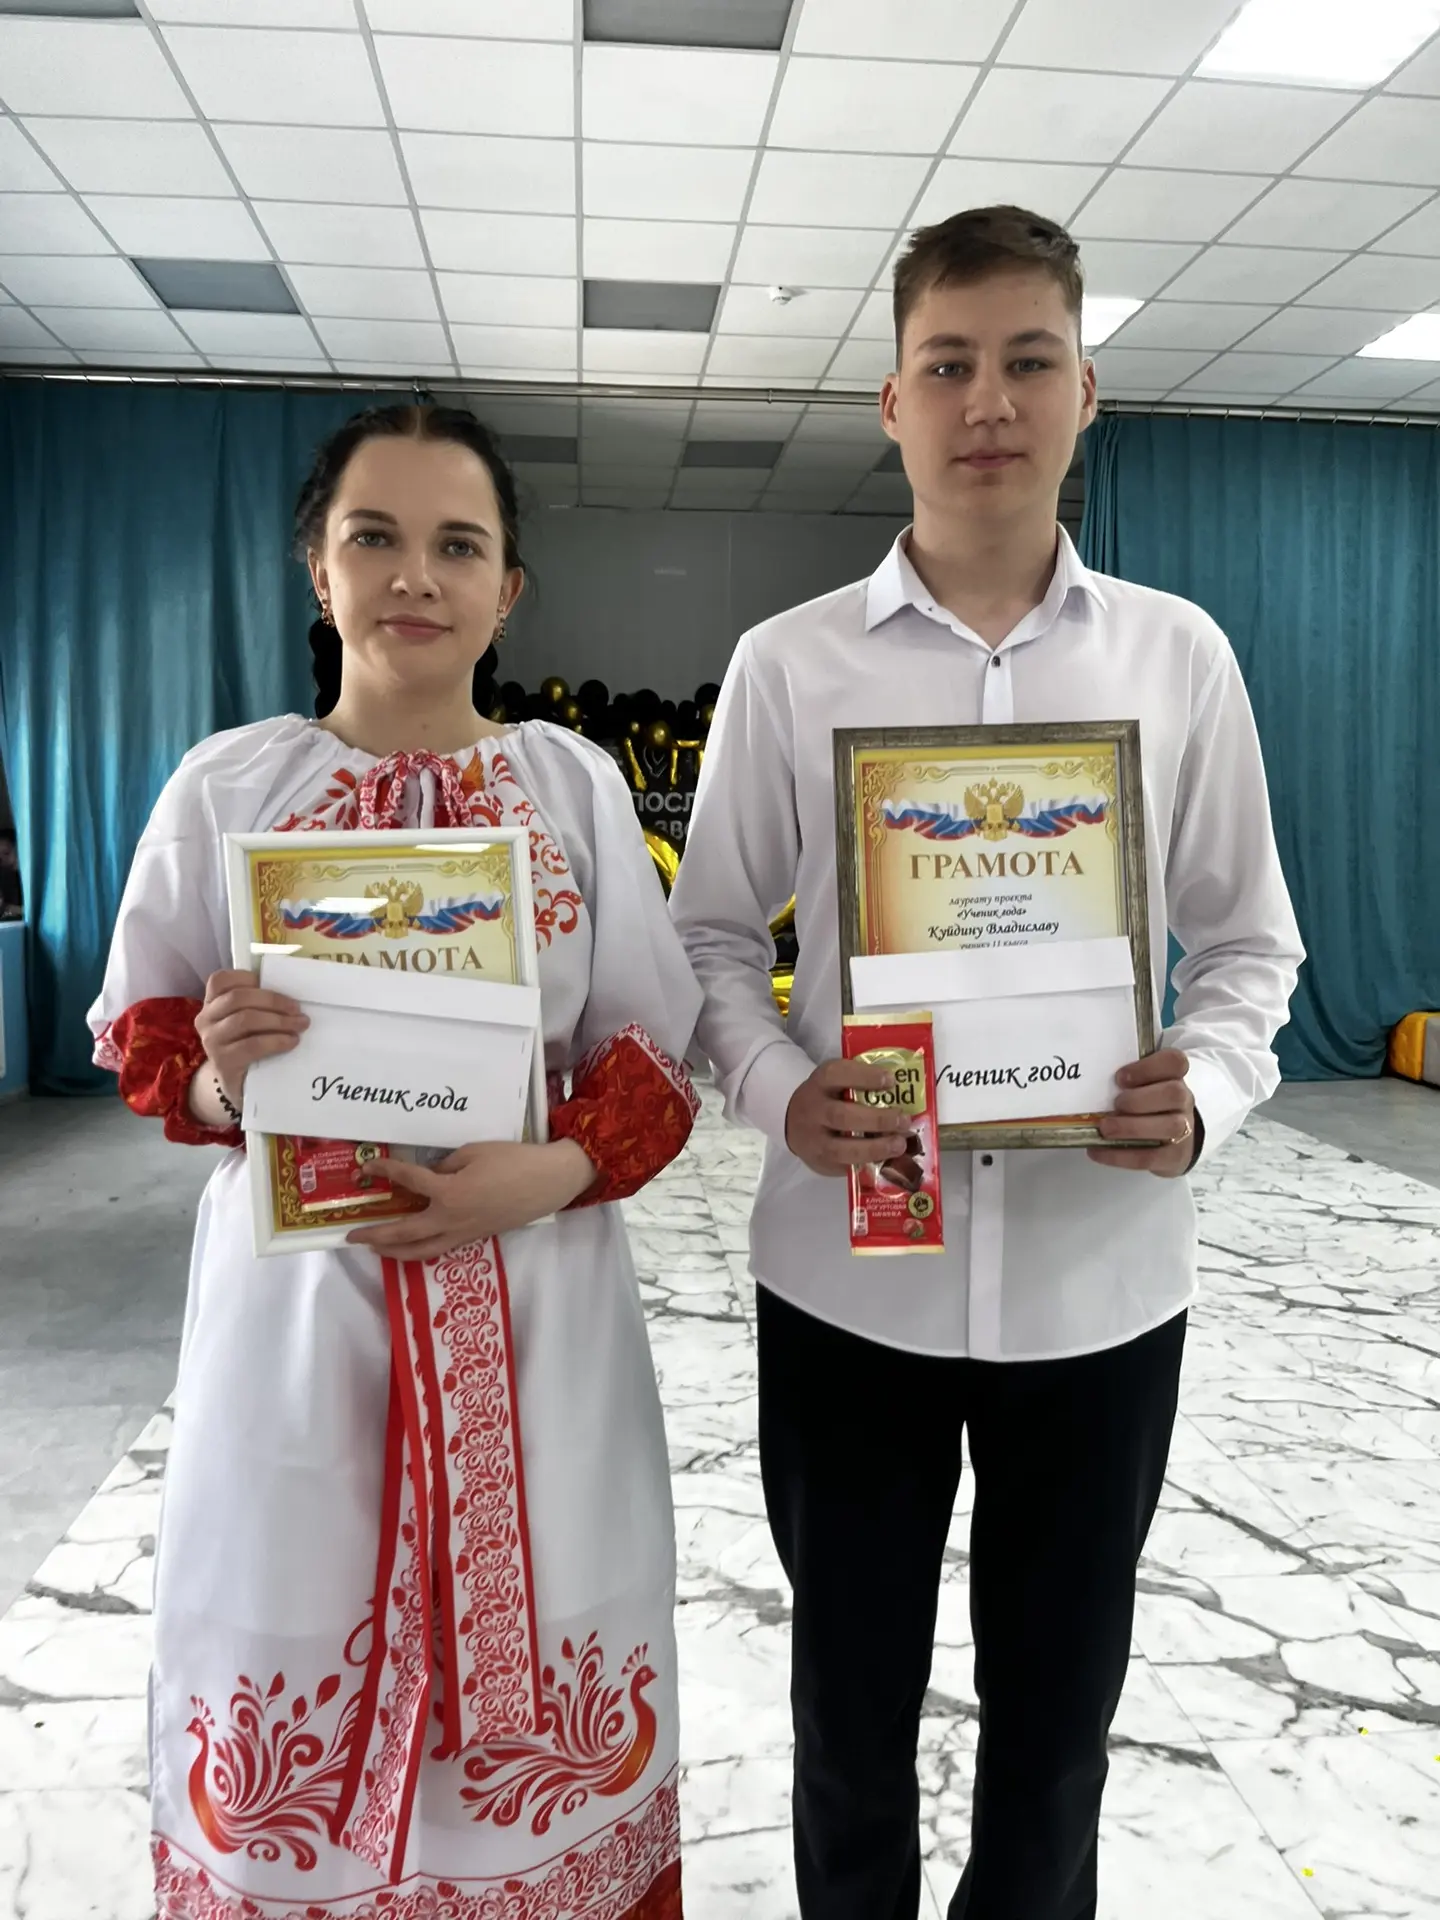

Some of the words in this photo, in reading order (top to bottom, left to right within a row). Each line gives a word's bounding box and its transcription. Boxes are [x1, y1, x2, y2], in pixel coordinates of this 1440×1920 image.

[909, 851, 1085, 879] ГРАМОТА
[949, 895, 992, 908] лауреату
[994, 893, 1033, 906] проекта
[927, 922, 984, 942] Куйдину
[986, 920, 1060, 935] Владиславу
[312, 945, 484, 973] РАМОТА
[1027, 1056, 1082, 1082] года
[311, 1075, 414, 1112] Ученик
[415, 1086, 468, 1112] года
[864, 1083, 915, 1106] Gold
